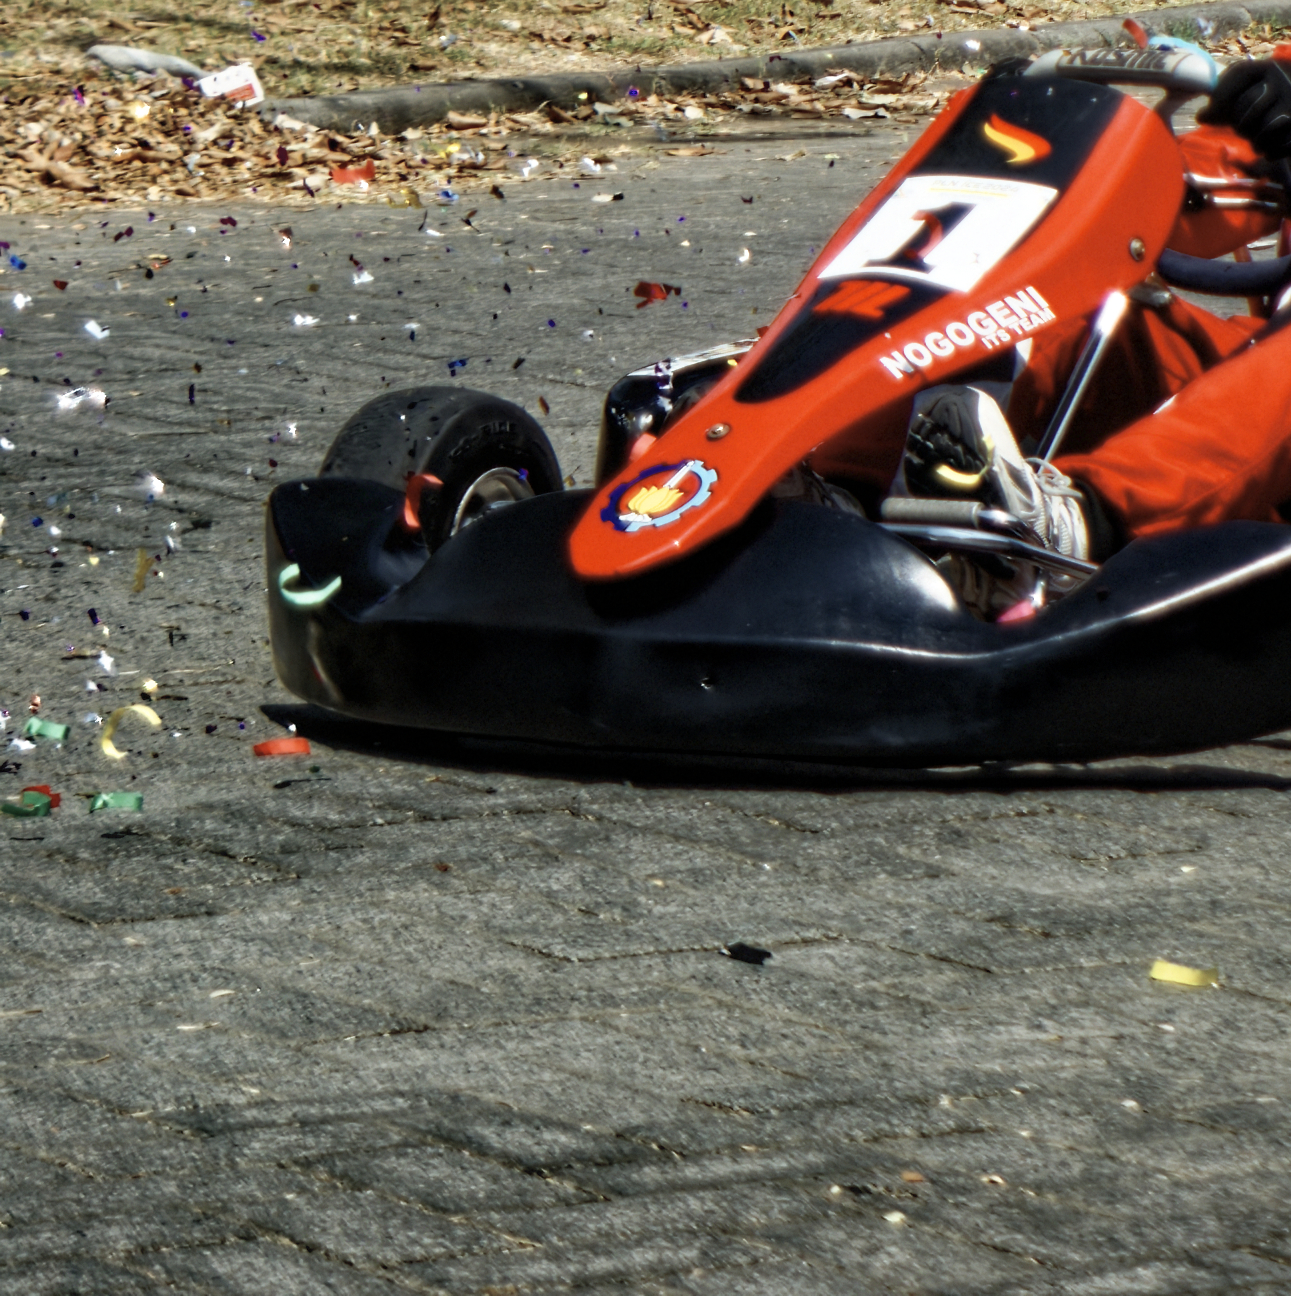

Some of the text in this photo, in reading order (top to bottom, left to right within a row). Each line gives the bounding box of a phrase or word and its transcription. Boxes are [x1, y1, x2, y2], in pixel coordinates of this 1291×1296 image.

[861, 201, 977, 275] 1
[879, 286, 1050, 379] NOGOGENI
[981, 306, 1057, 350] ITS TEAM
